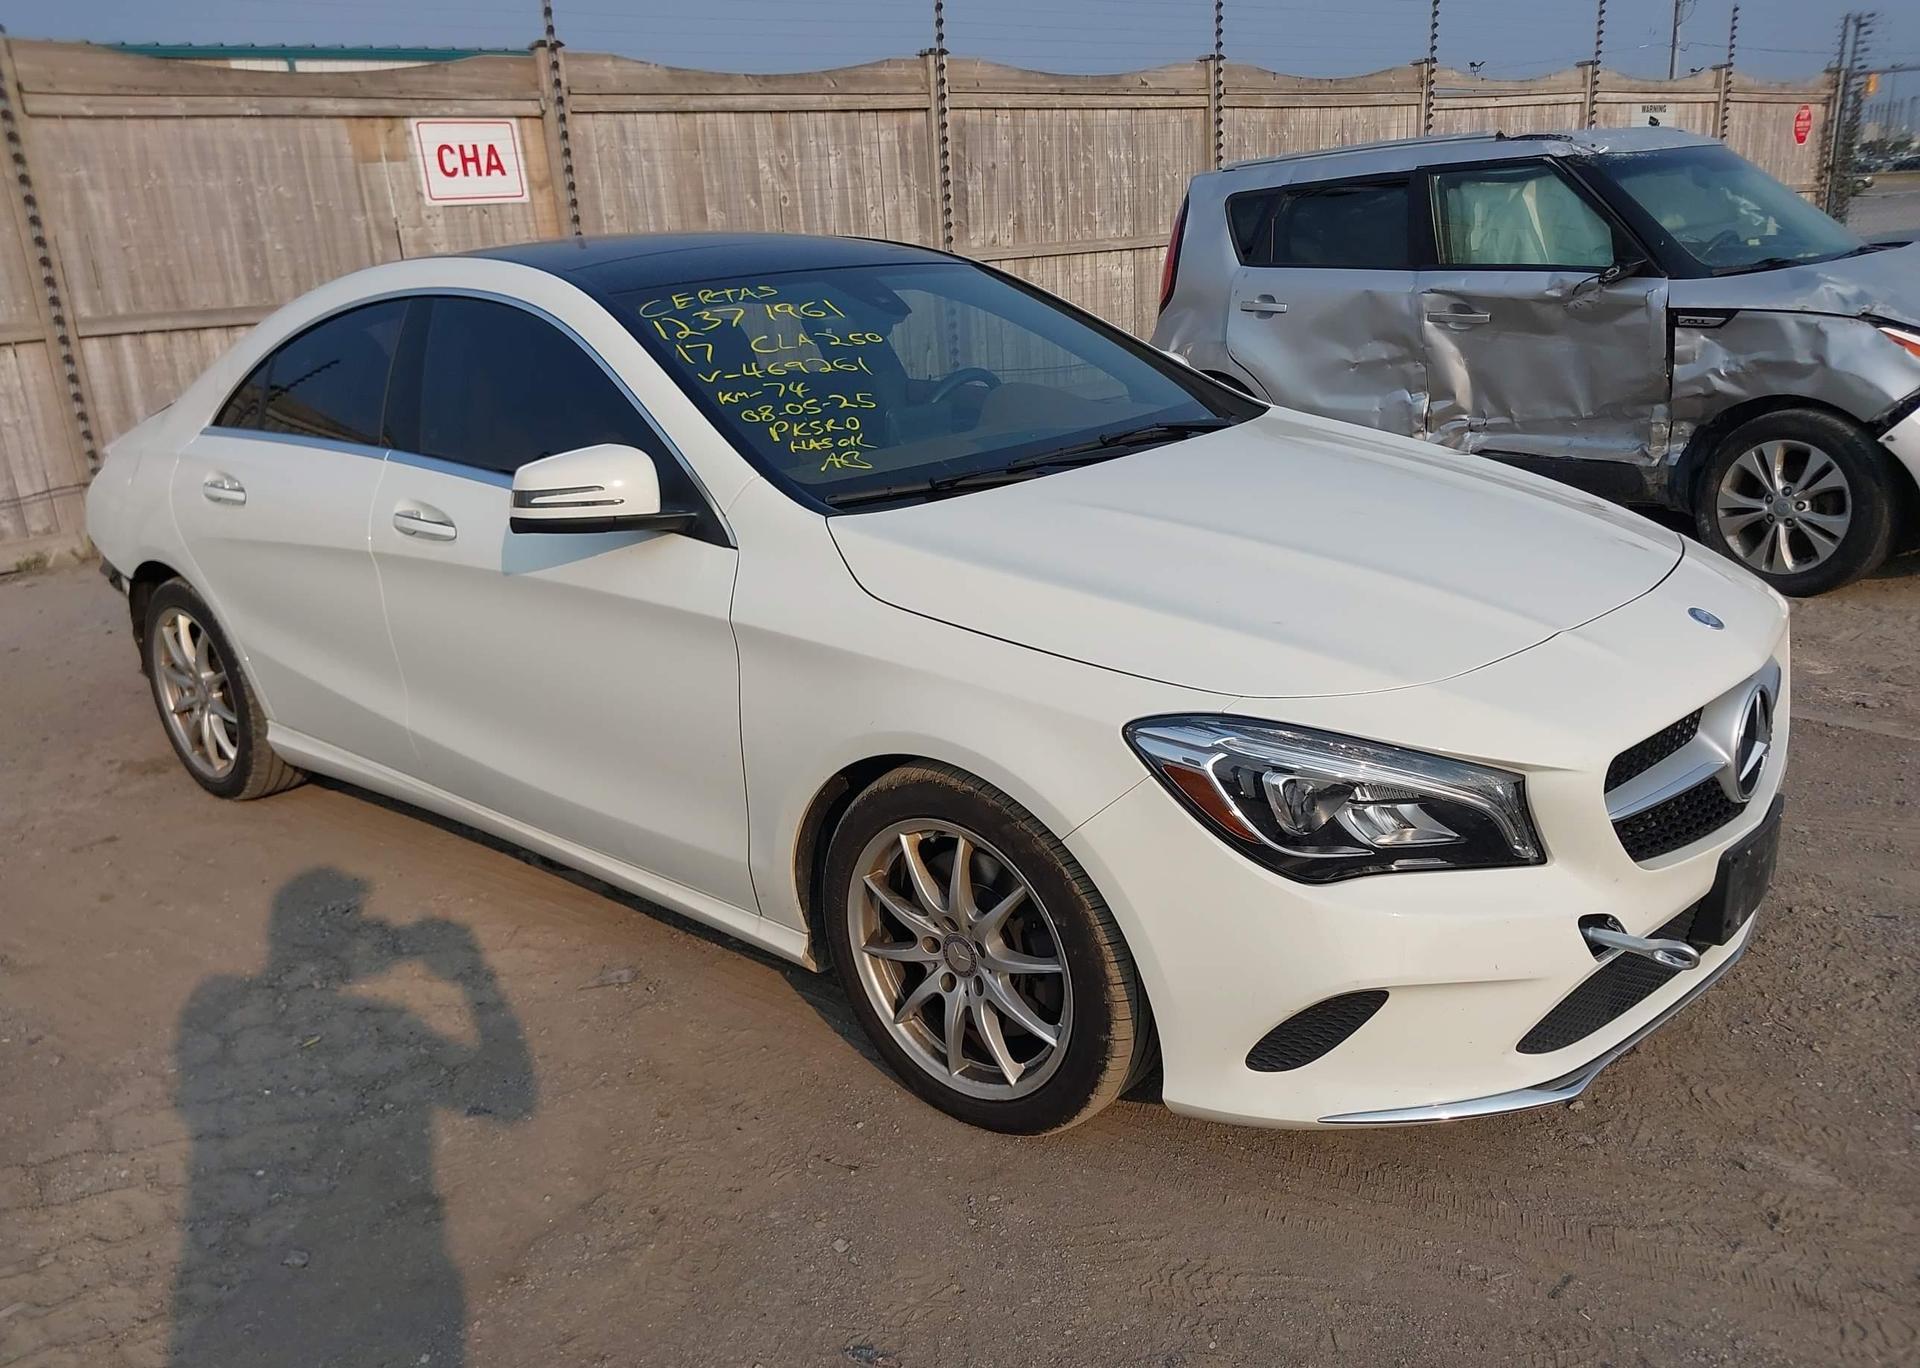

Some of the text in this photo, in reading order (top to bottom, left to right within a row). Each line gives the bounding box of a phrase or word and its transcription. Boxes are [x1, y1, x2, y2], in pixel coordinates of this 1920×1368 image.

[1641, 104, 1667, 113] WARNING
[437, 144, 507, 178] CHA
[751, 334, 817, 354] CLA
